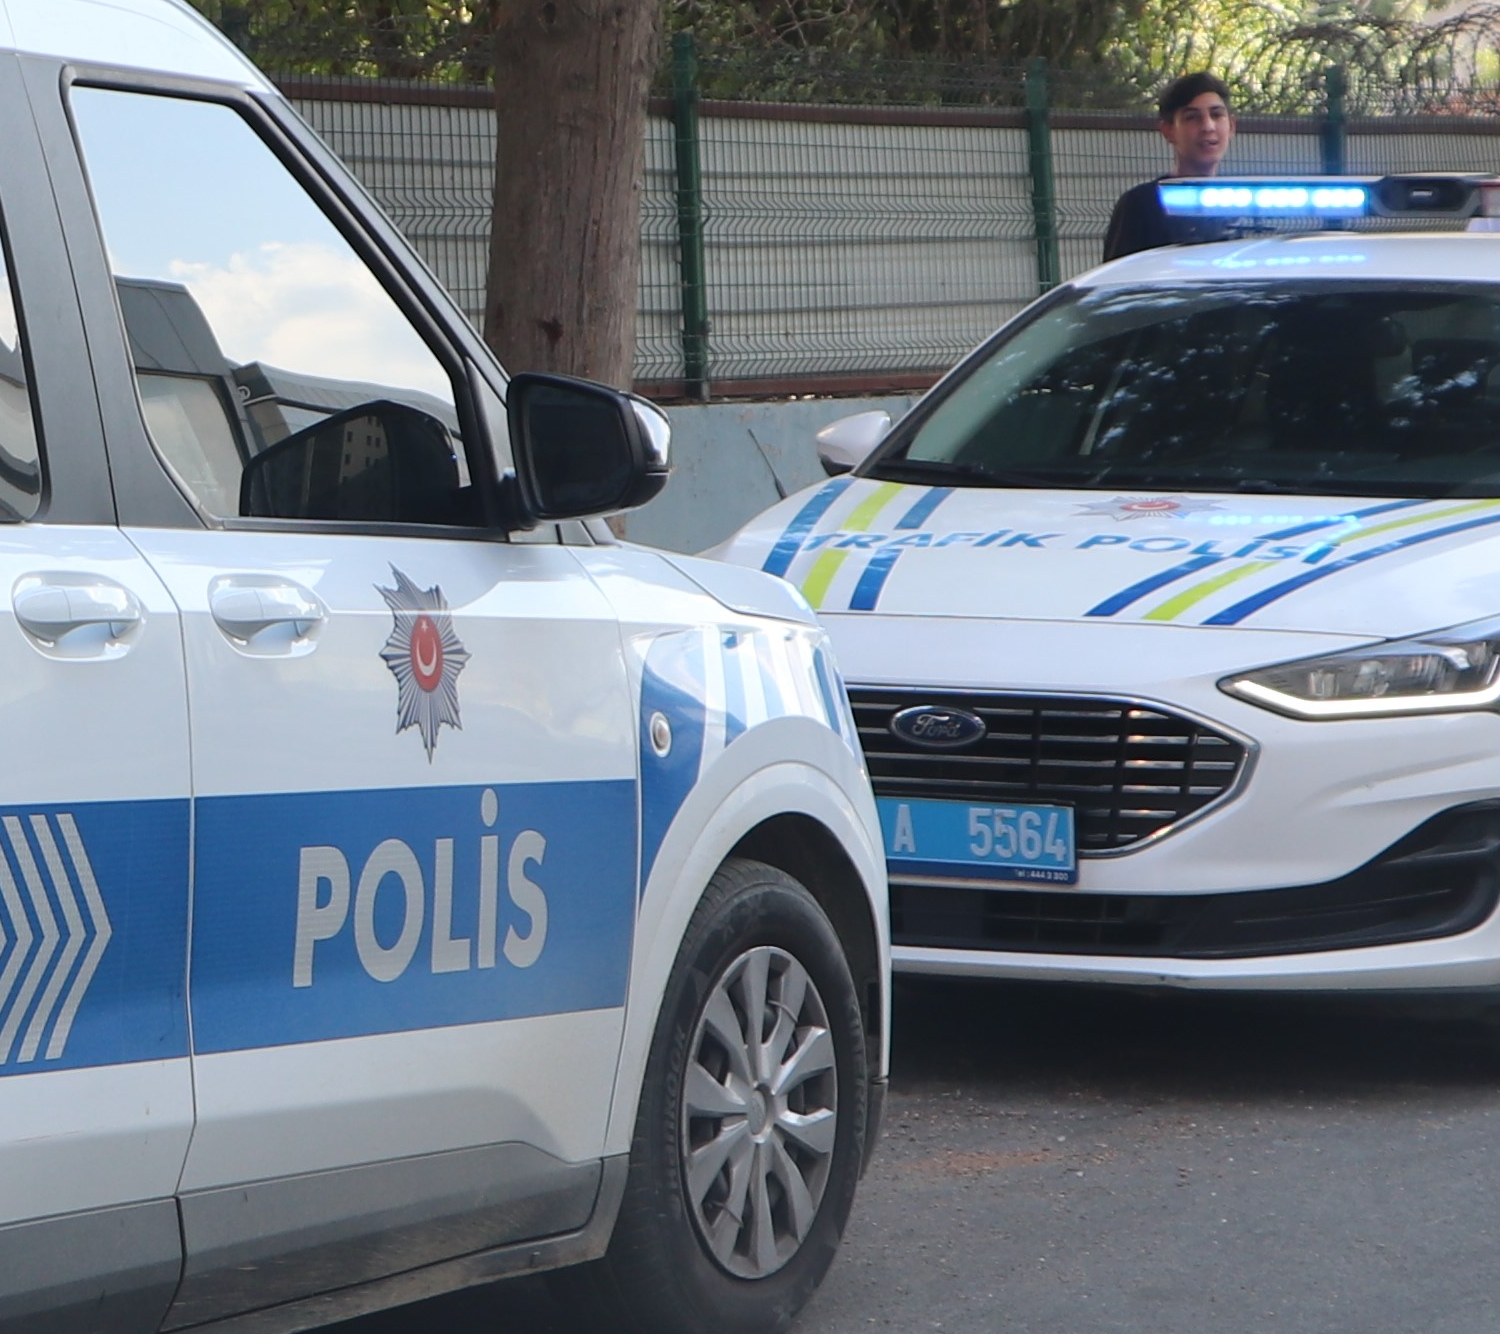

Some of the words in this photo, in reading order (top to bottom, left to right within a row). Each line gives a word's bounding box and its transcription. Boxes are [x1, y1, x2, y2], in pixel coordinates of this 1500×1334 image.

[802, 527, 1066, 551] TRAFİK
[911, 713, 962, 738] Ford
[892, 803, 916, 854] A
[968, 806, 1067, 862] 5564
